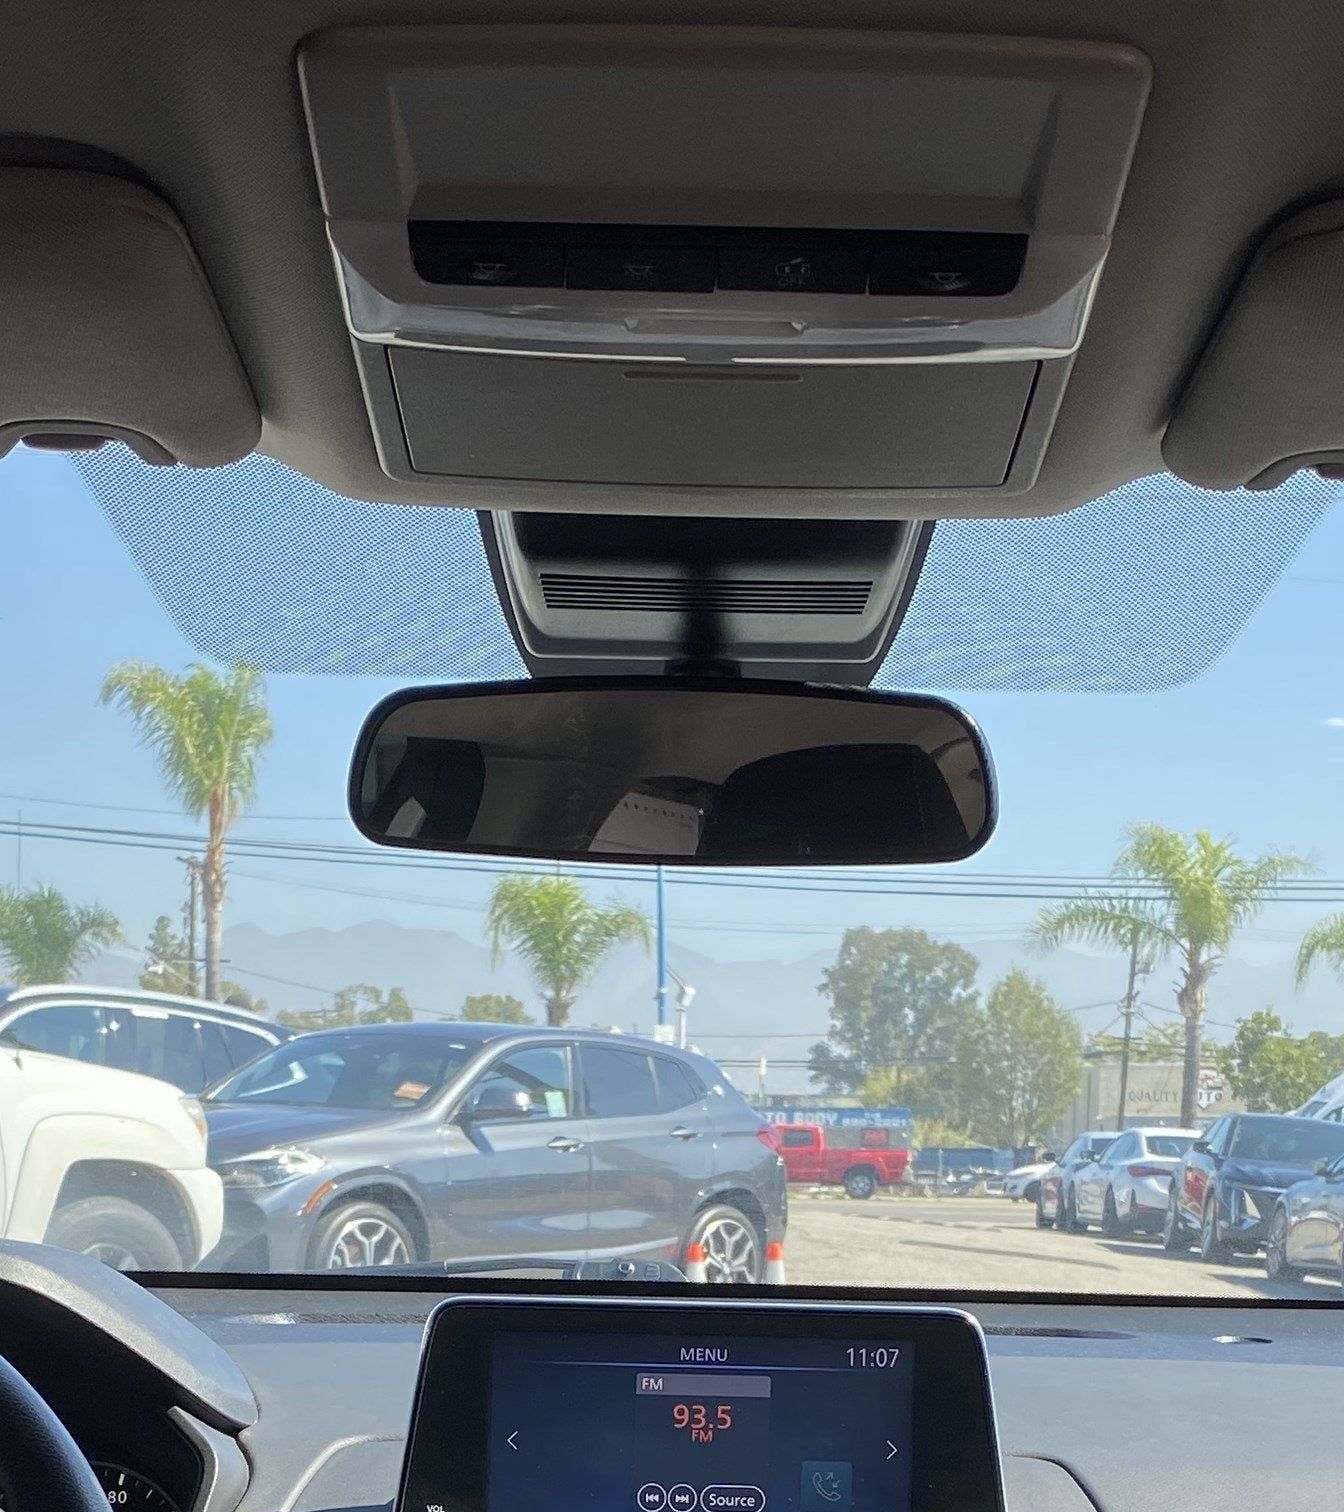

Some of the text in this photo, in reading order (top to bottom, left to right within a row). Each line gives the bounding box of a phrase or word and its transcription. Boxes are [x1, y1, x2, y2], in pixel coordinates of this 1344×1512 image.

[1128, 1090, 1178, 1102] QUALITY
[793, 1111, 838, 1126] BODY
[679, 1347, 729, 1361] MENU
[846, 1347, 900, 1368] 11:07
[641, 1377, 664, 1391] FM
[672, 1403, 733, 1430] 93.5
[691, 1430, 714, 1443] FM
[107, 1489, 127, 1505] 80
[708, 1493, 756, 1507] Source
